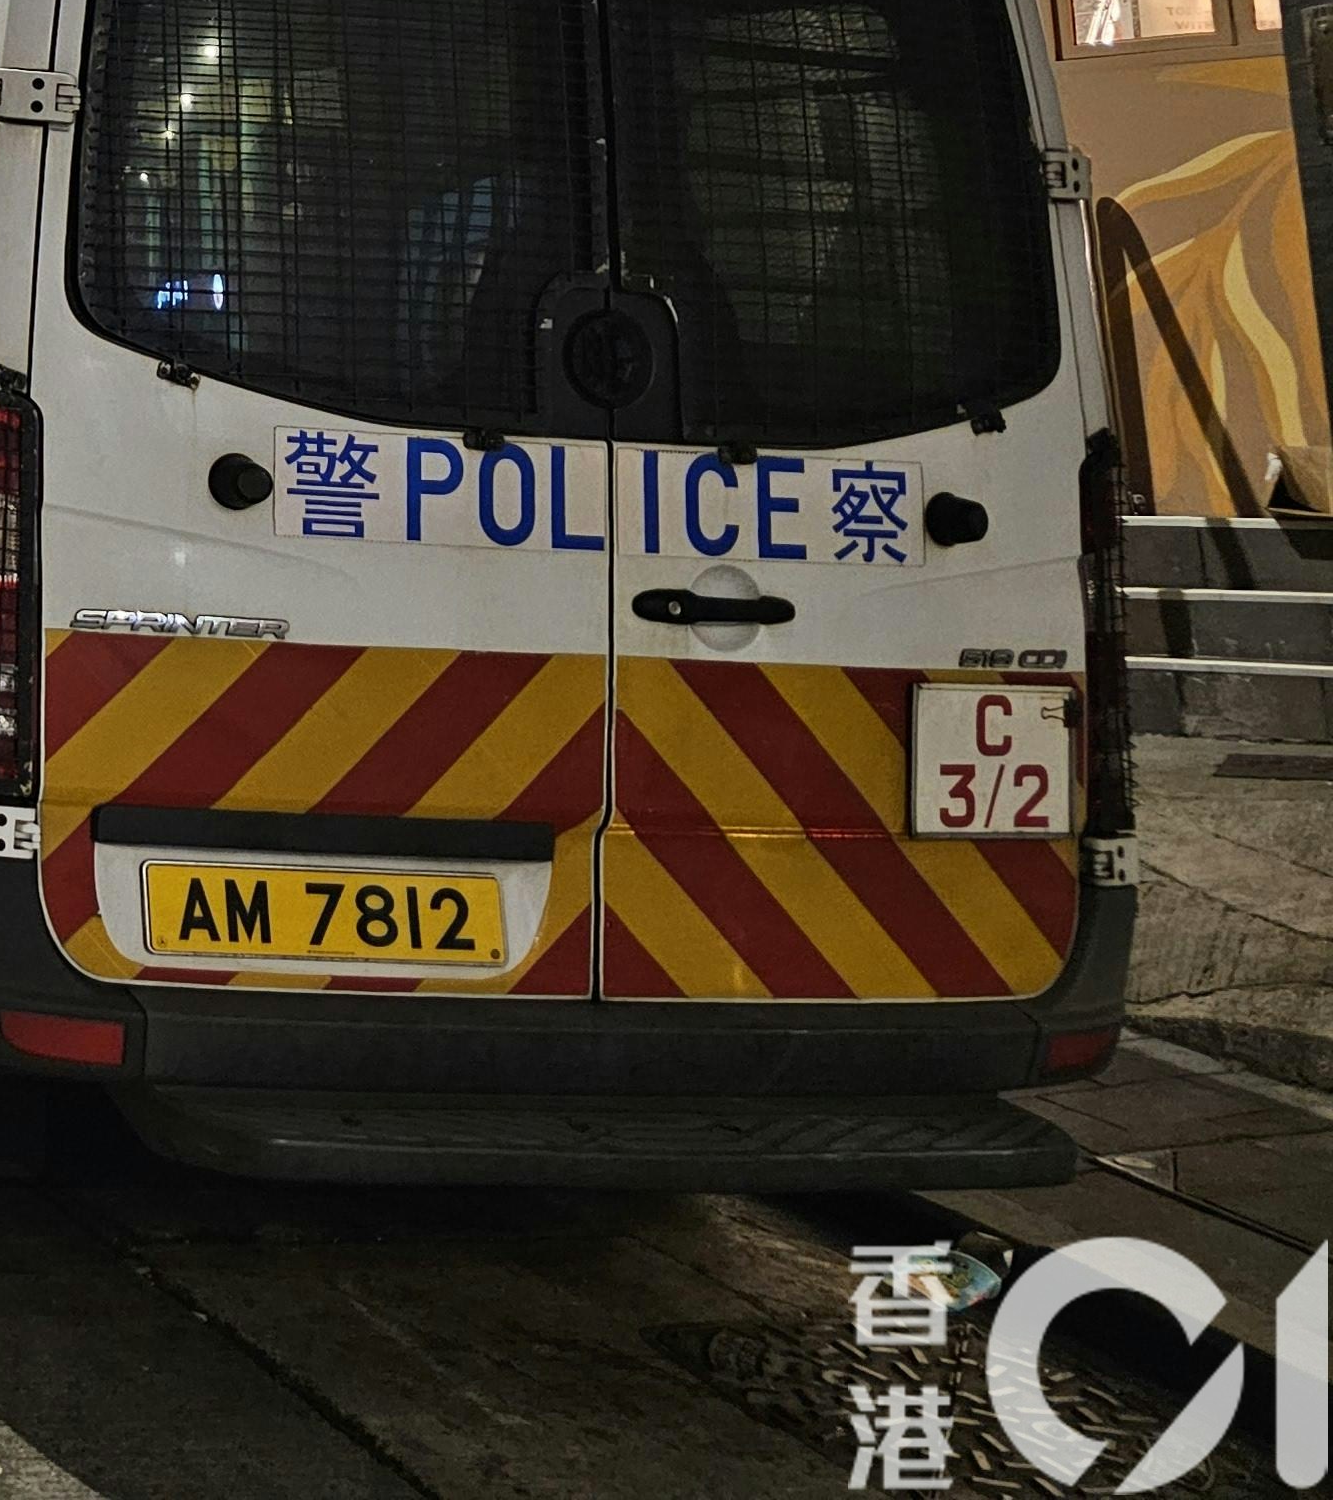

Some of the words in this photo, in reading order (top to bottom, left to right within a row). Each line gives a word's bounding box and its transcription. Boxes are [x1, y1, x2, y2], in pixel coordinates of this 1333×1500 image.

[284, 430, 379, 538] 警
[407, 436, 807, 560] POLICE
[831, 462, 908, 563] 察
[71, 609, 289, 639] SPRINTER
[1018, 649, 1067, 669] CDI
[976, 694, 1012, 756] C
[940, 764, 1049, 828] 3/2
[178, 878, 271, 943] AM
[305, 882, 475, 950] 7812
